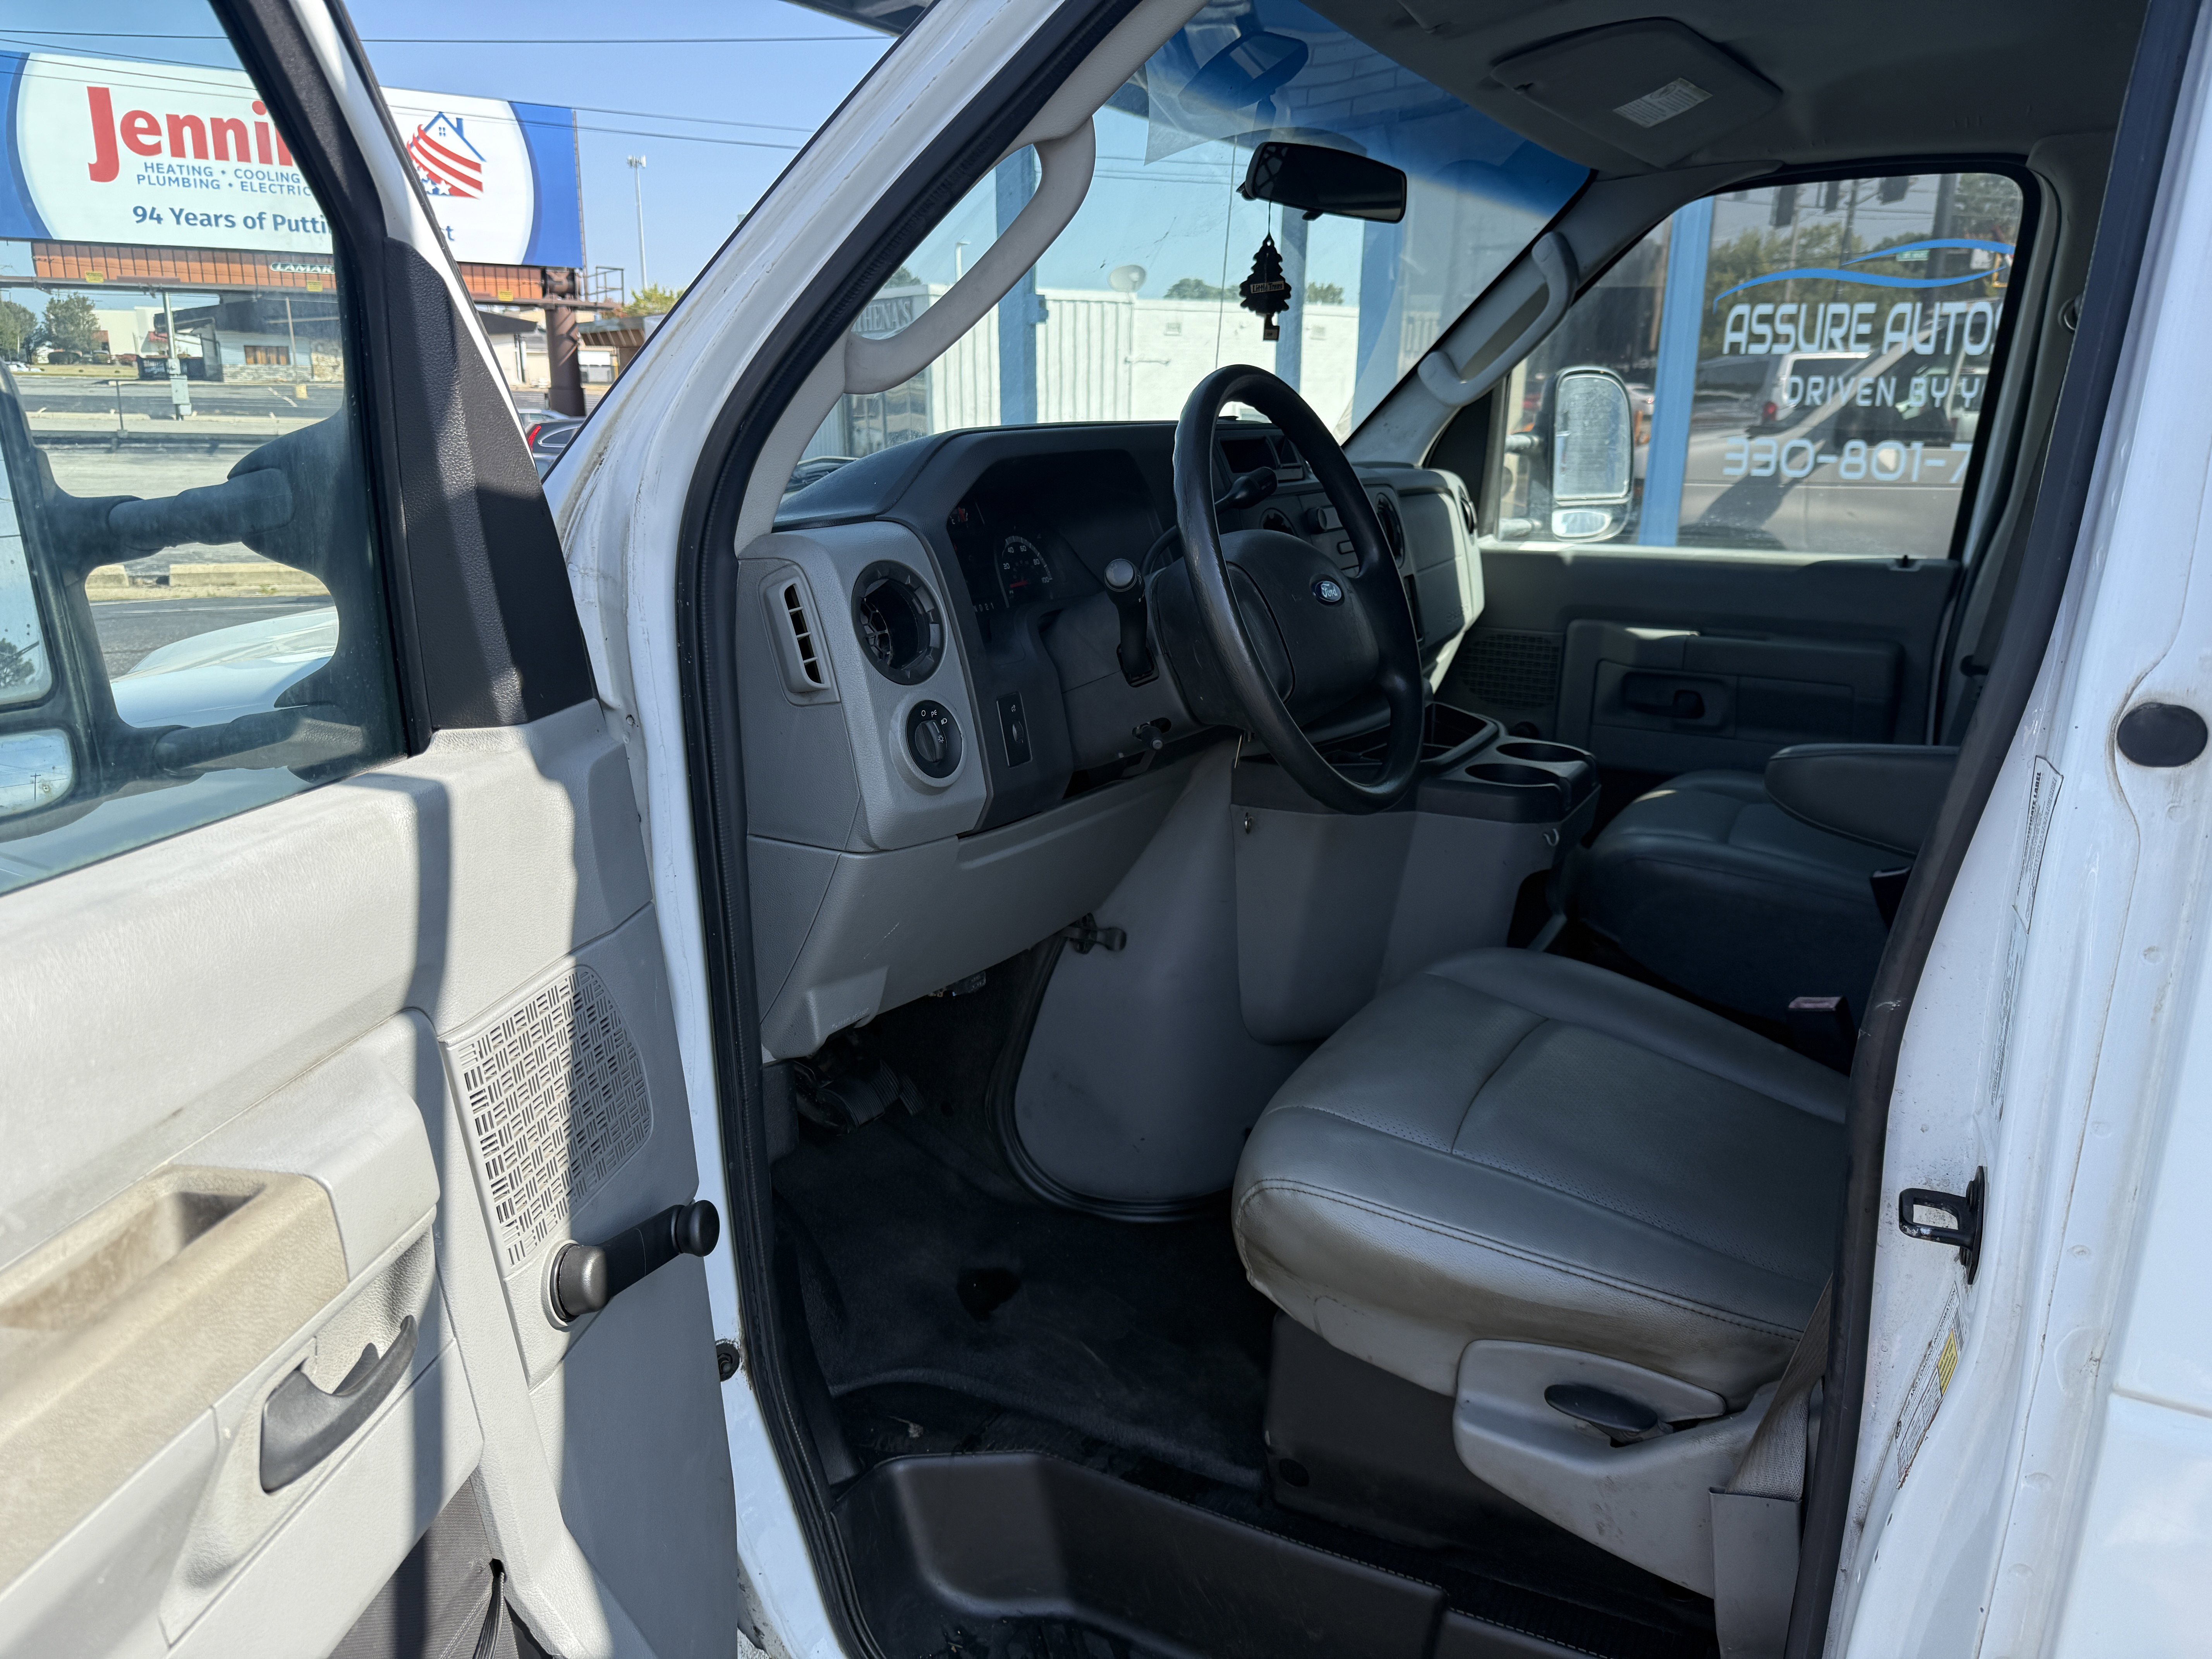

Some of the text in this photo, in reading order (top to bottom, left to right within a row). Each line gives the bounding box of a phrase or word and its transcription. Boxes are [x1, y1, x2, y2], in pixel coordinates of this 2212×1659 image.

[136, 174, 220, 190] PLUMBING
[144, 161, 301, 184] HEATING COOLING
[132, 205, 332, 234] 94 Years of Putti
[276, 264, 333, 273] LAMAR
[851, 299, 912, 332] HENA'S
[1722, 302, 1877, 355] ASSURE
[1786, 375, 1985, 408] DRIVEN BY Y
[1321, 584, 1338, 598] Ford
[1918, 1346, 1934, 1381] LOADING
[1934, 1288, 1956, 1345] INFORMATION
